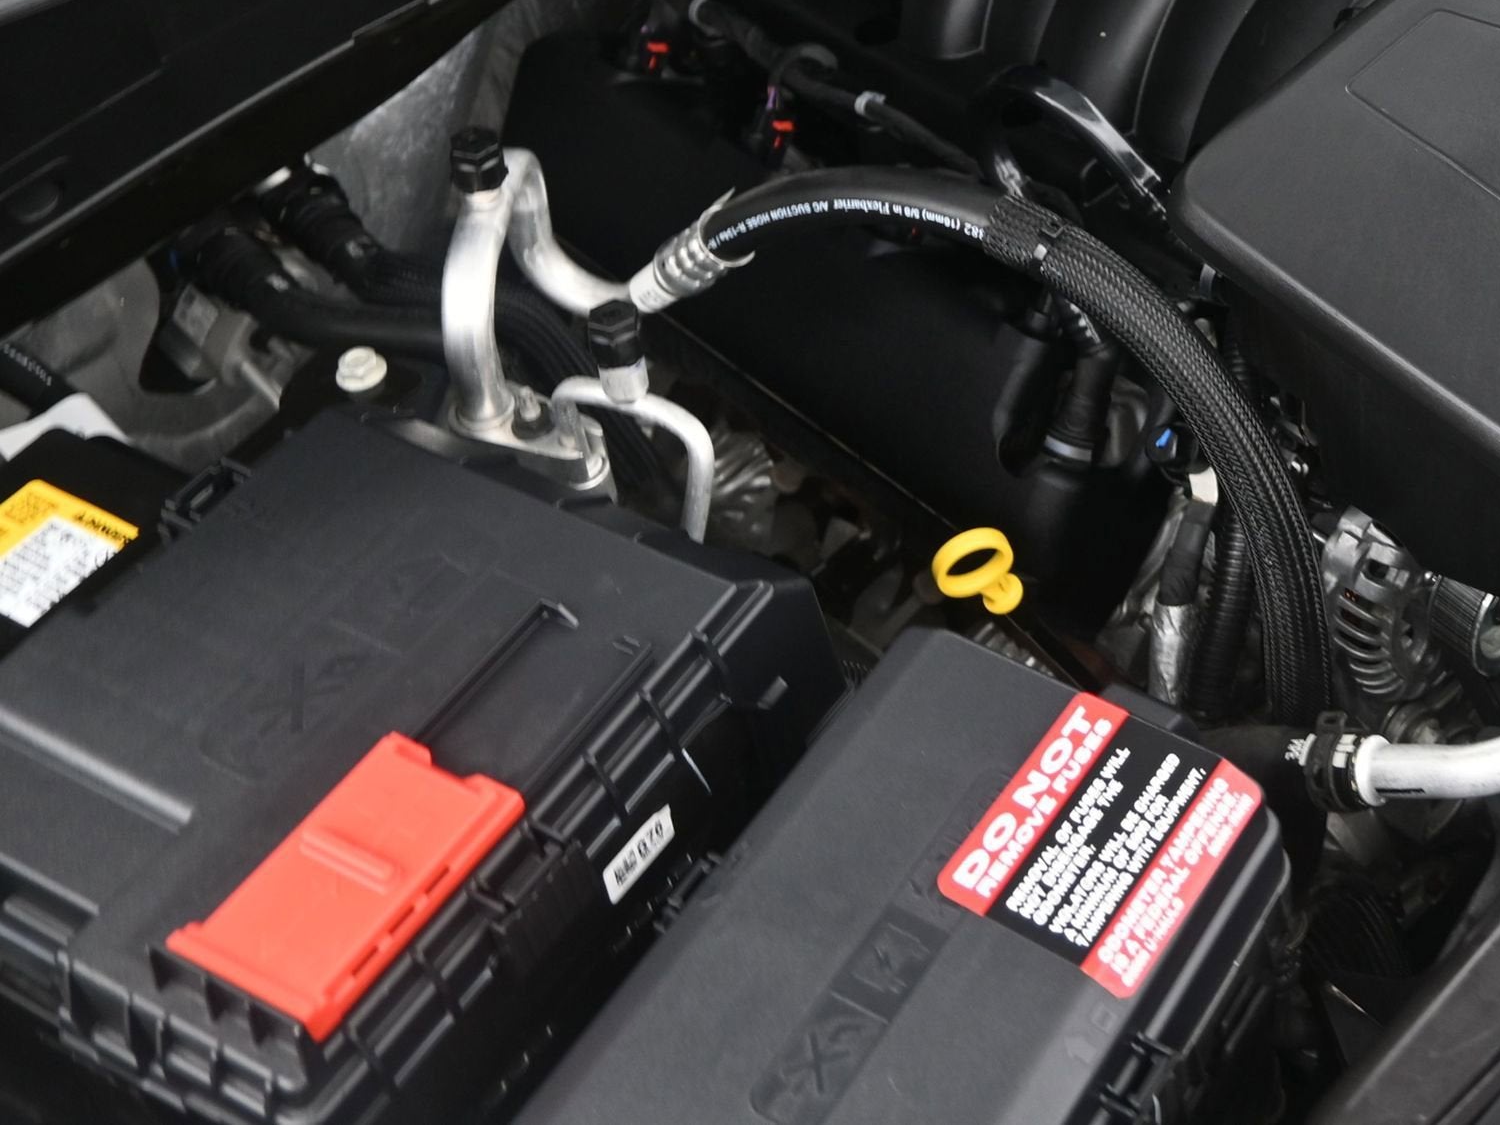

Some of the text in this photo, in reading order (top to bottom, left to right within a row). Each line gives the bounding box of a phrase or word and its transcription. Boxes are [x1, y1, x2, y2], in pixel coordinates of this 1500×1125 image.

[772, 203, 811, 220] SUCTION
[952, 706, 1091, 889] DO NOT
[976, 719, 1112, 898] REMOVE FUSES
[1006, 748, 1130, 912] REMOVAL OF FUSES WILL
[1019, 777, 1123, 918] NOT DISENGAGE THE
[1049, 754, 1179, 933] VIOLATORS WILL BE CHARGED
[1070, 867, 1122, 931] MINIMUM
[1113, 847, 1130, 869] OF
[1144, 794, 1169, 823] FOR
[1075, 872, 1133, 946] TAMPERING
[1126, 838, 1156, 873] WITH
[1098, 869, 1167, 965] ODOMETER
[1160, 778, 1228, 869] TAMPERING
[1133, 867, 1190, 939] FEDERAL
[1110, 952, 1133, 977] IS
[1126, 939, 1141, 958] A
